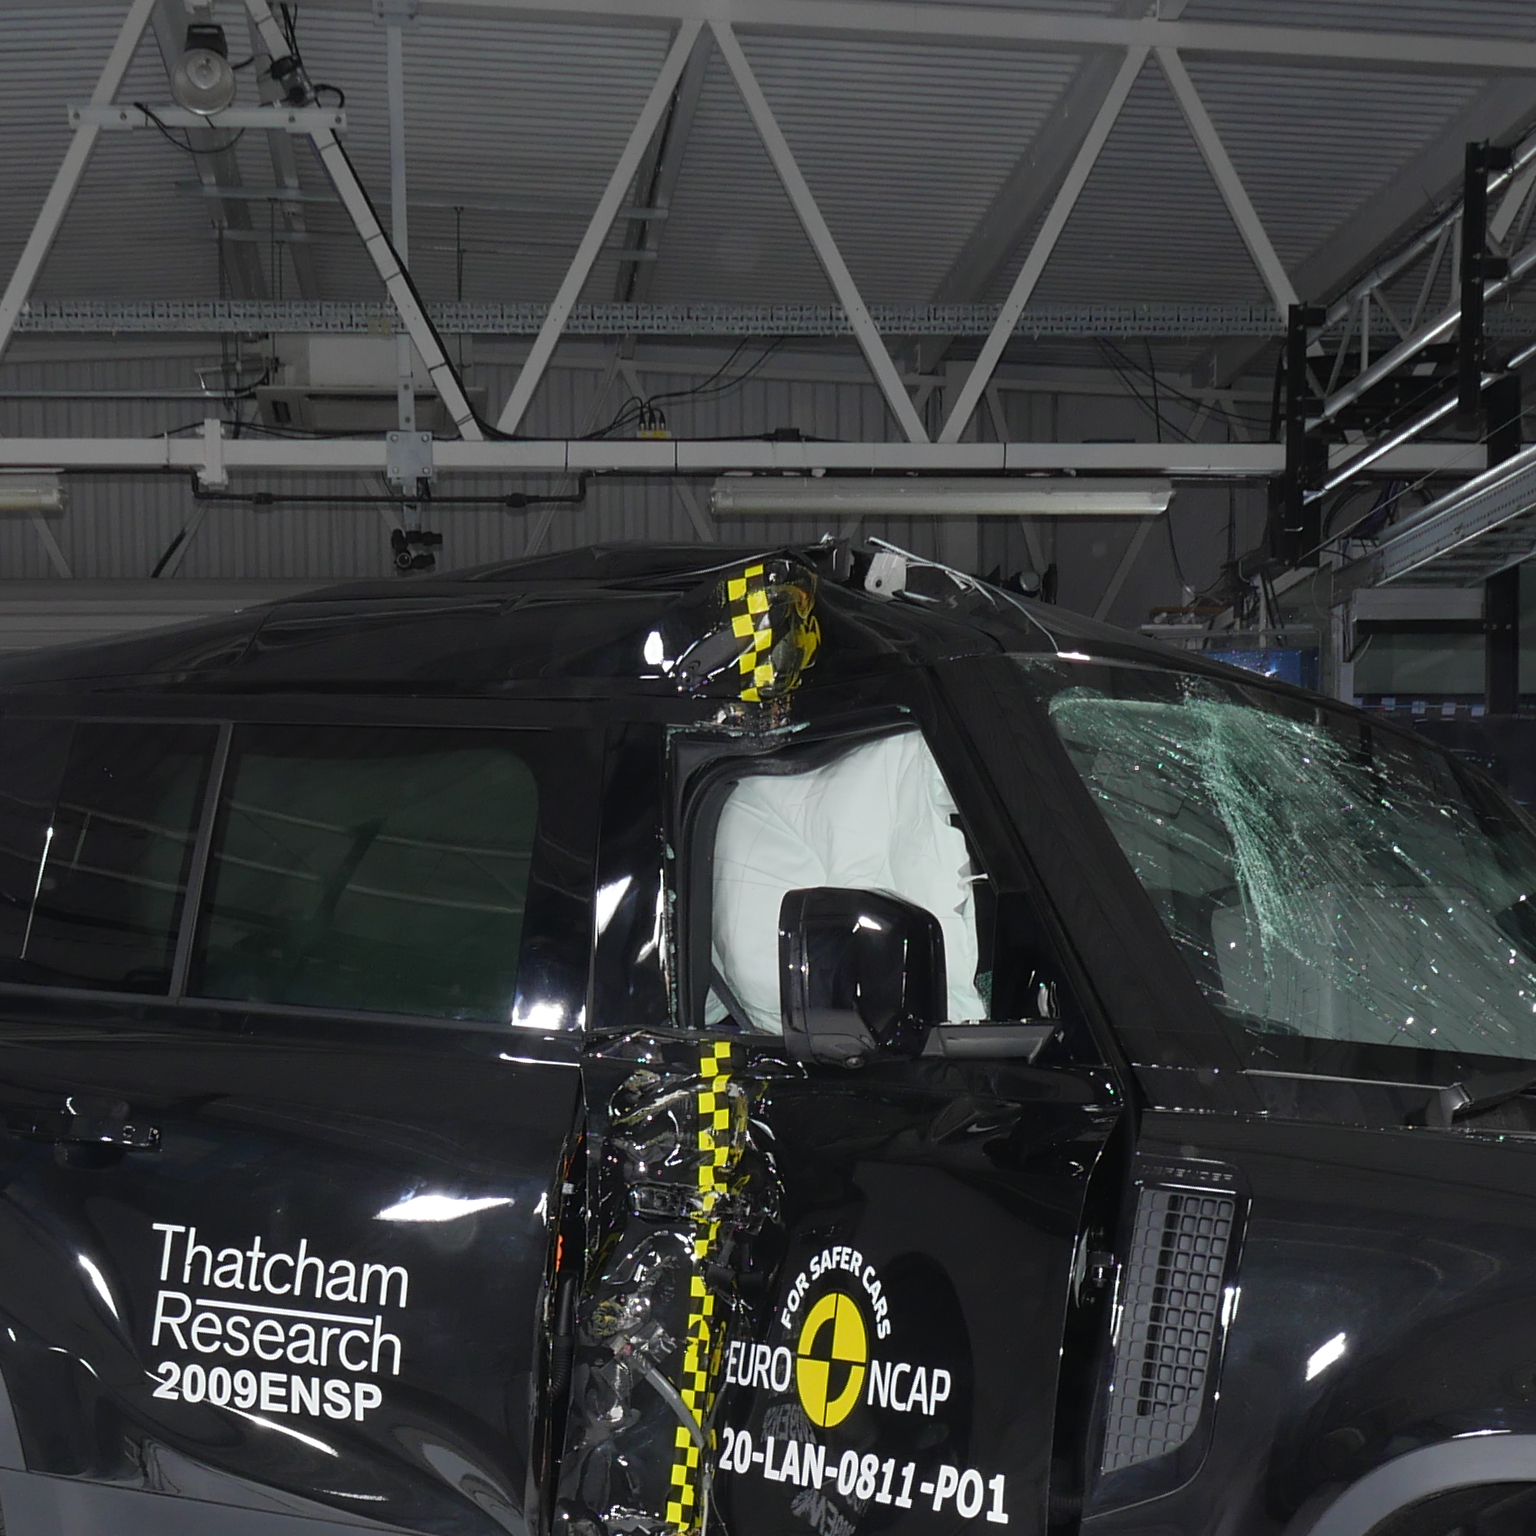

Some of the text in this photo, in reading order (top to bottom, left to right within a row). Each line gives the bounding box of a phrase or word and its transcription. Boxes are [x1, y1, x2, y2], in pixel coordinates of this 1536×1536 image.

[152, 1222, 409, 1308] Thatcham
[781, 1246, 892, 1340] FOR SAFER CARS
[151, 1290, 402, 1376] Research
[152, 1361, 383, 1422] 2009ENSP
[725, 1340, 952, 1416] EURO NCAP
